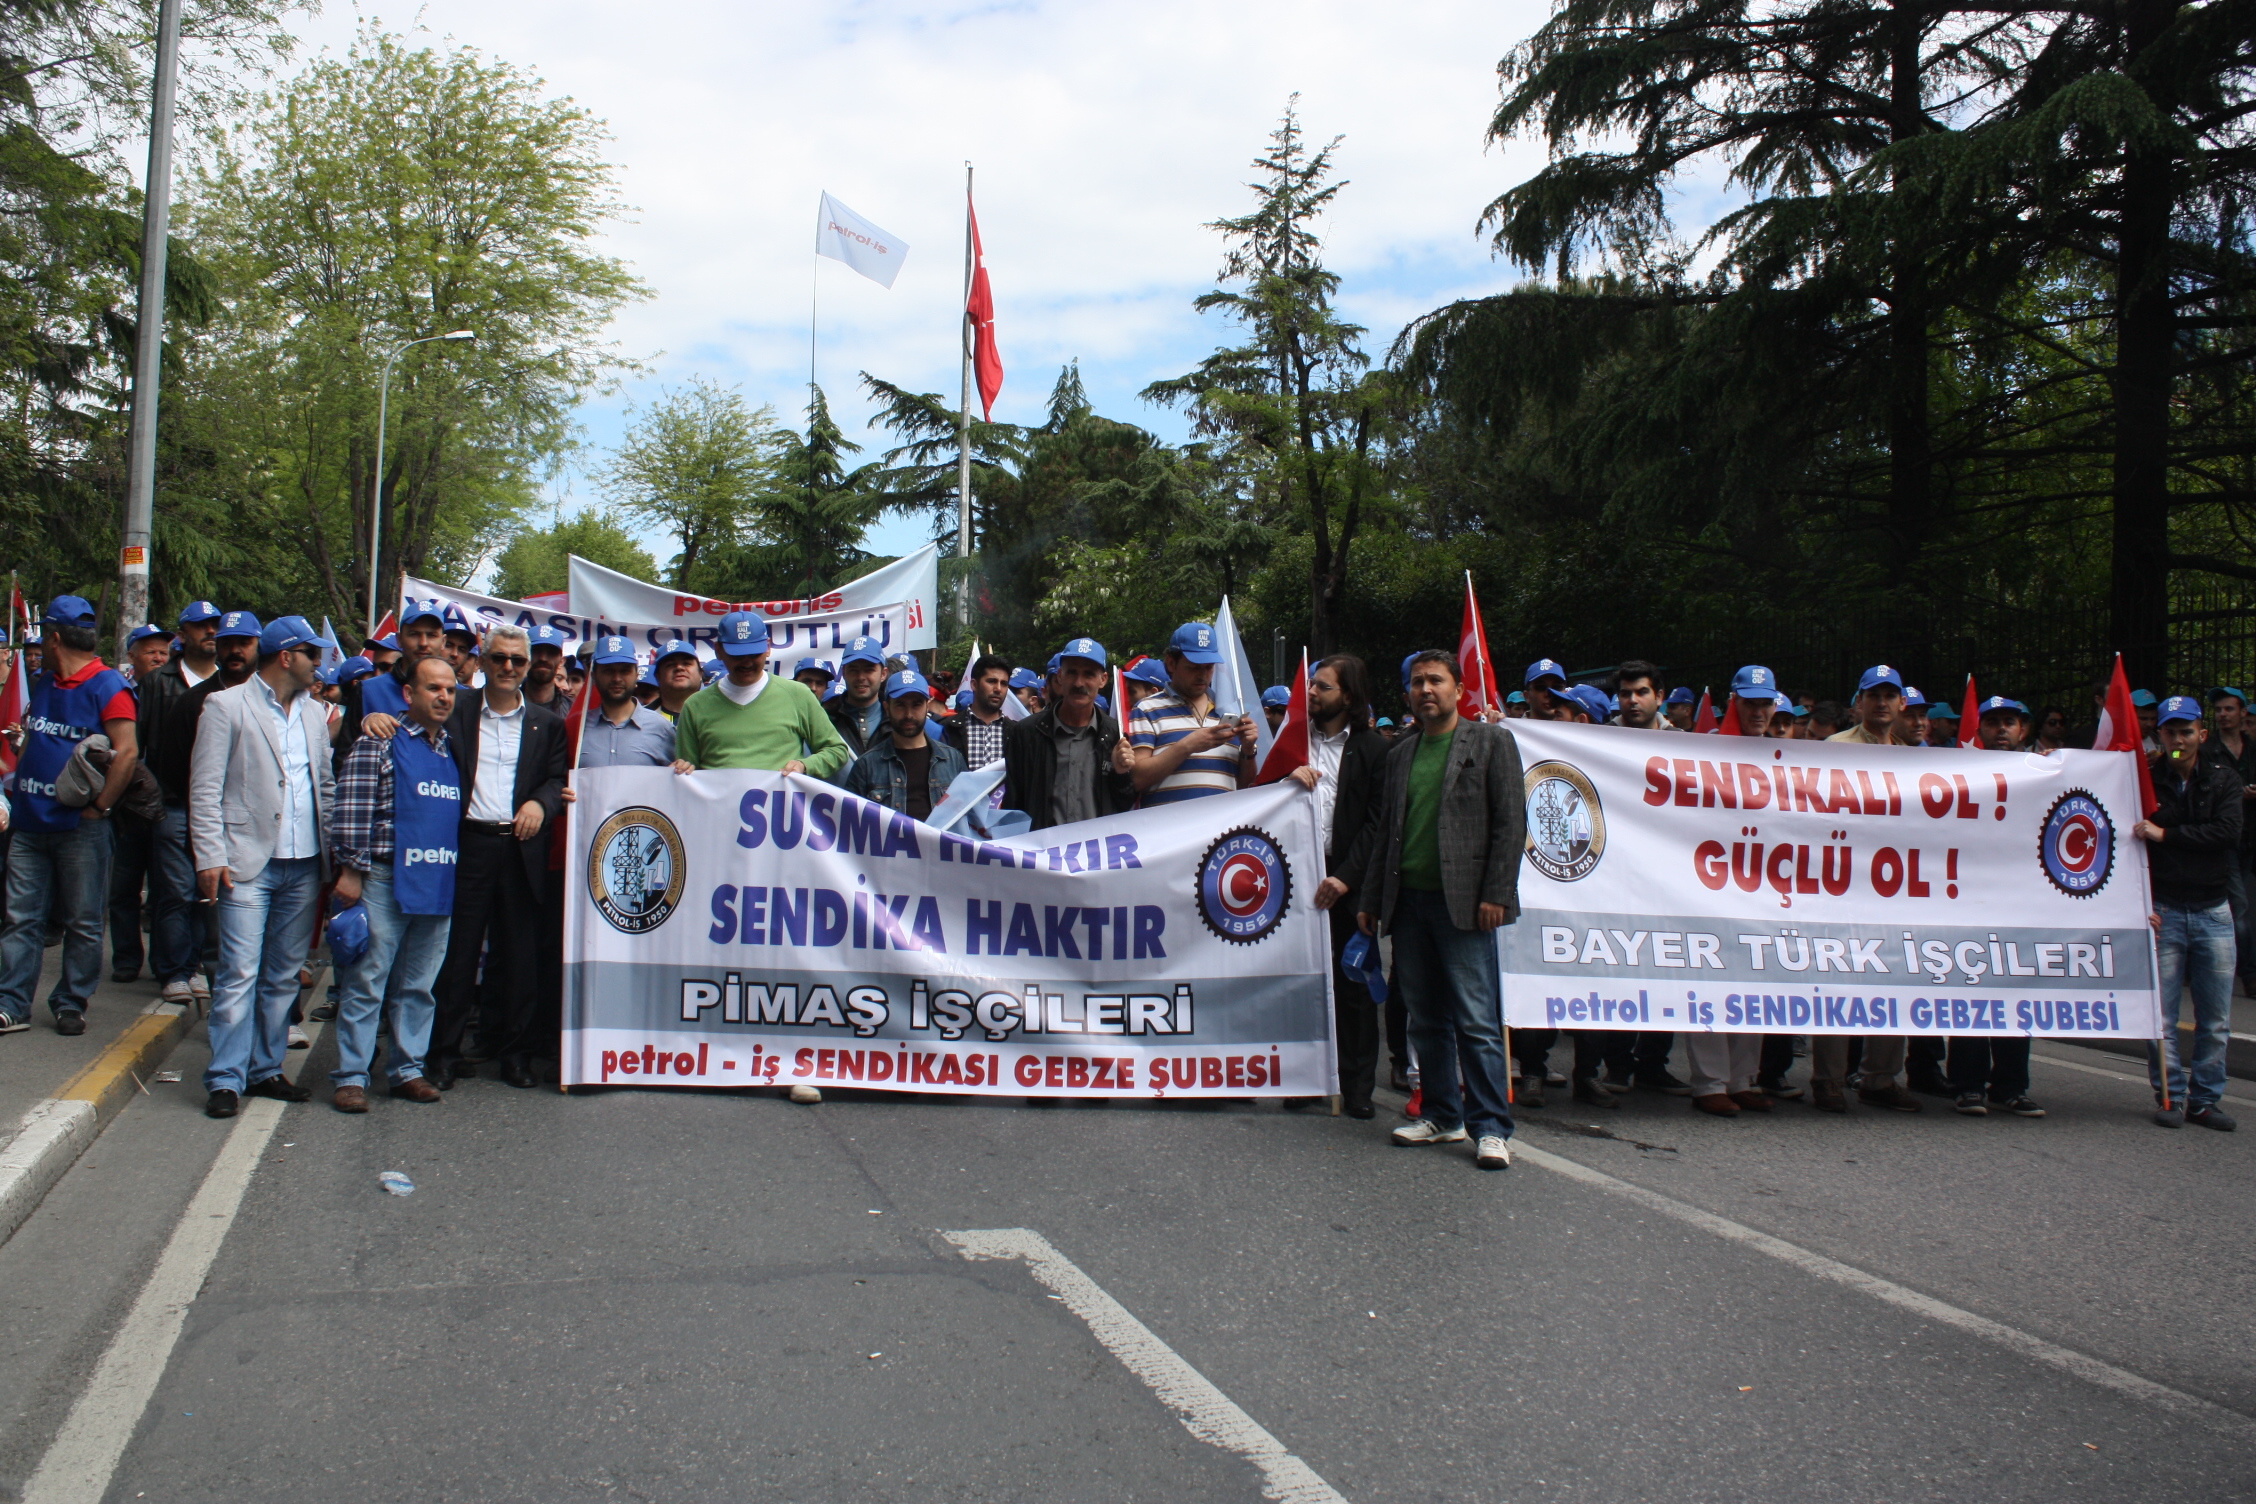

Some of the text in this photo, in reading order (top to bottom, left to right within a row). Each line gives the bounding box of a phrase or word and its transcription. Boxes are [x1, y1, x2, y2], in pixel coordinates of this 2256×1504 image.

[1643, 749, 1902, 817] SENDİKALI
[1919, 772, 1980, 820] OL
[736, 788, 922, 860] SUSMA
[1208, 838, 1276, 872] TÜRK-İŞ
[1574, 855, 1594, 875] 1950
[1693, 825, 1852, 909] GÜÇLÜ
[1870, 846, 1931, 898] OL
[2060, 871, 2098, 888] 1952
[602, 901, 668, 931] PETROL-İŞ 1950
[708, 873, 1168, 961] SENDİKA HAKTIR
[1223, 914, 1269, 933] 1952
[1541, 925, 2115, 985] BAYER TÜRK İŞÇİLERİ
[680, 971, 1195, 1042] PİMAŞ İŞÇİLERİ
[1546, 989, 1650, 1030] petrol
[1686, 990, 1715, 1033] iş
[1725, 986, 1899, 1029] SENDİKASI
[1909, 997, 2007, 1030] GEBZE
[2016, 991, 2121, 1038] ŞUBESİ
[601, 1042, 709, 1083] petrol
[750, 1043, 781, 1086] iş
[791, 1041, 1000, 1088] SENDİKASI
[1013, 1054, 1135, 1090] GEBZE
[1147, 1043, 1282, 1098] ŞUBESİ
